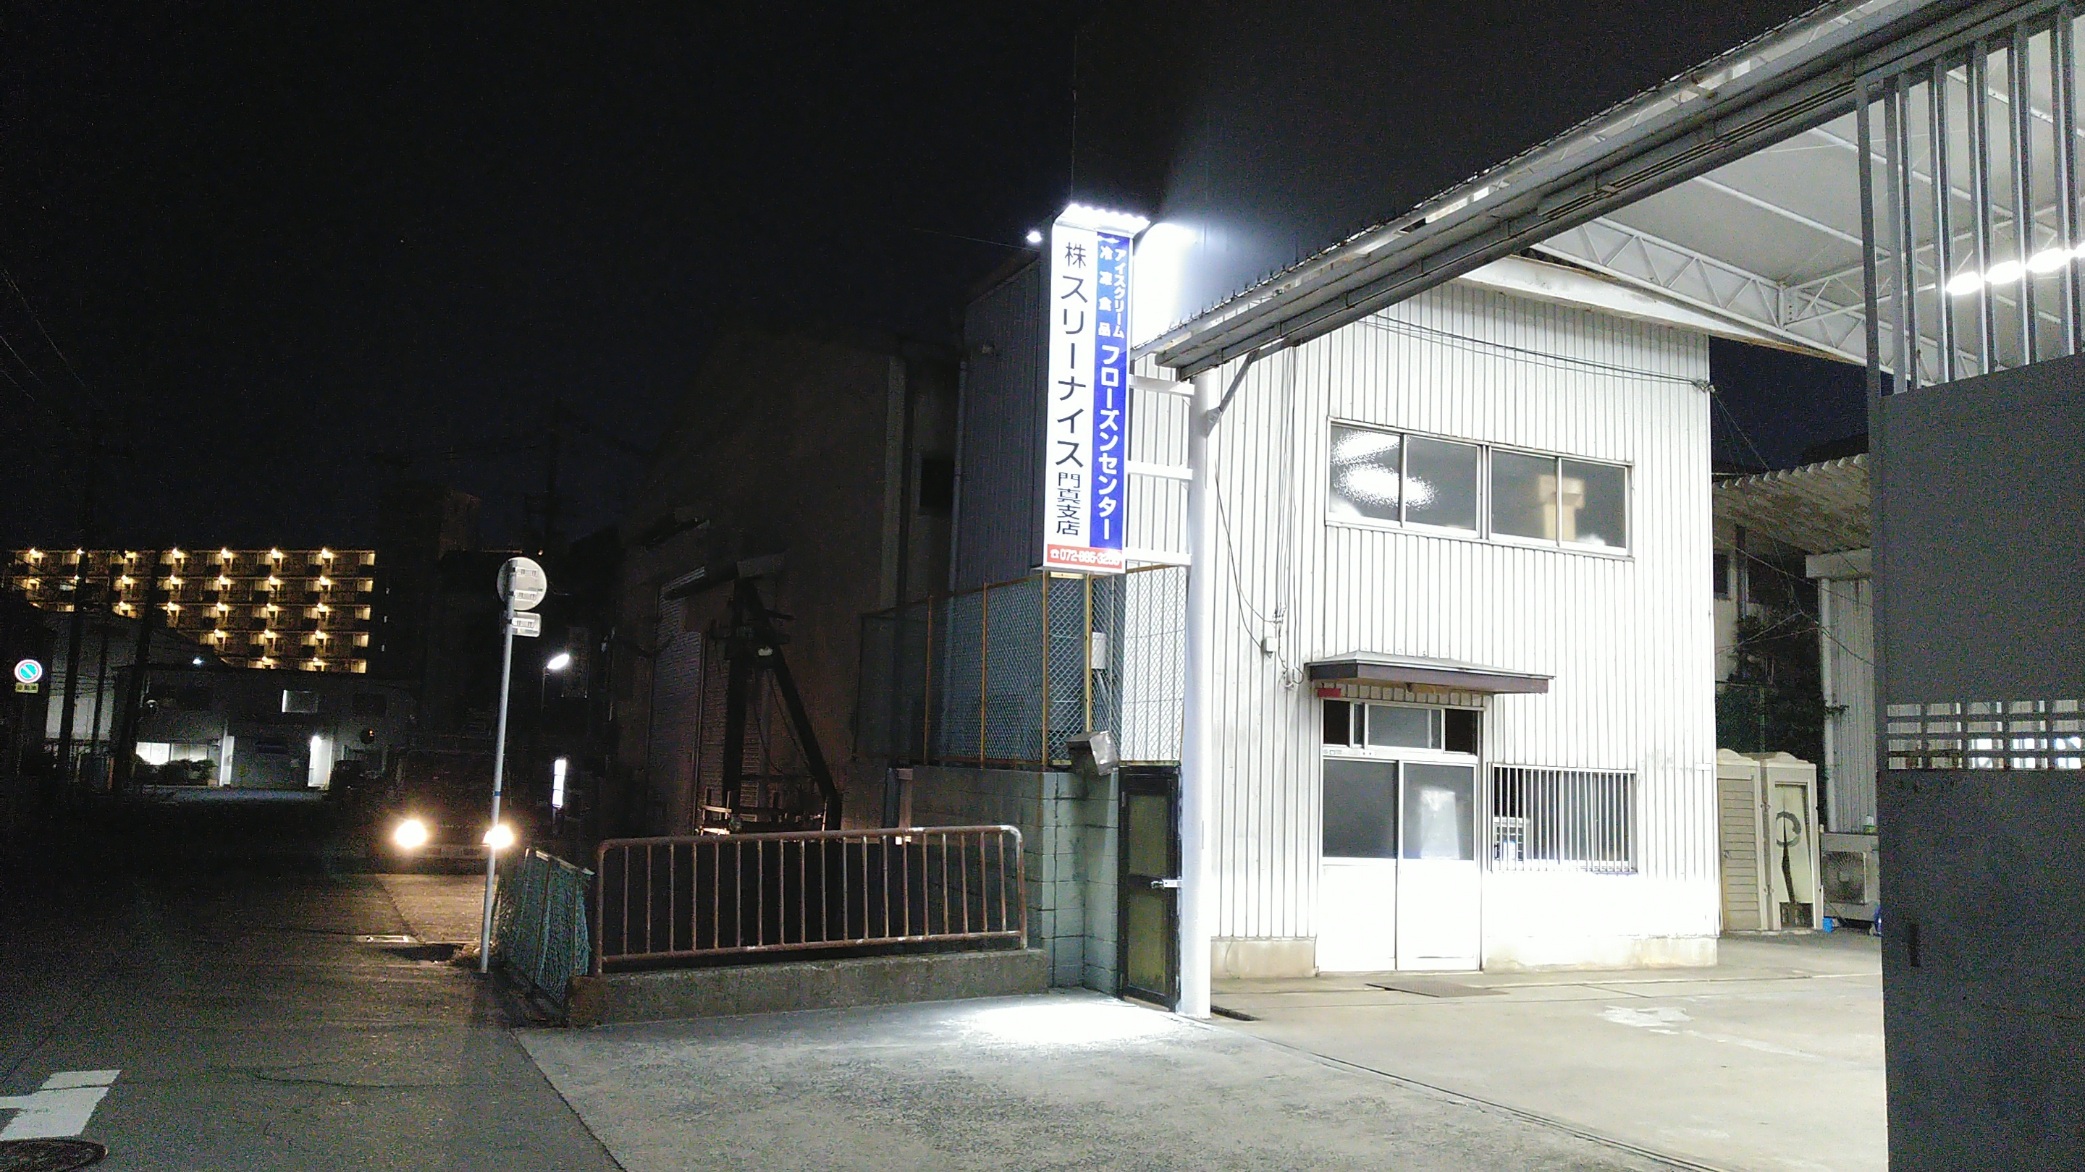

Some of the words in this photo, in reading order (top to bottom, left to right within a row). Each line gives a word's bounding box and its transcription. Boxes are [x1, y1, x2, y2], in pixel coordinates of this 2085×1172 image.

[1113, 249, 1128, 339] アイスクリーム
[1098, 345, 1120, 540] フローズンセンター
